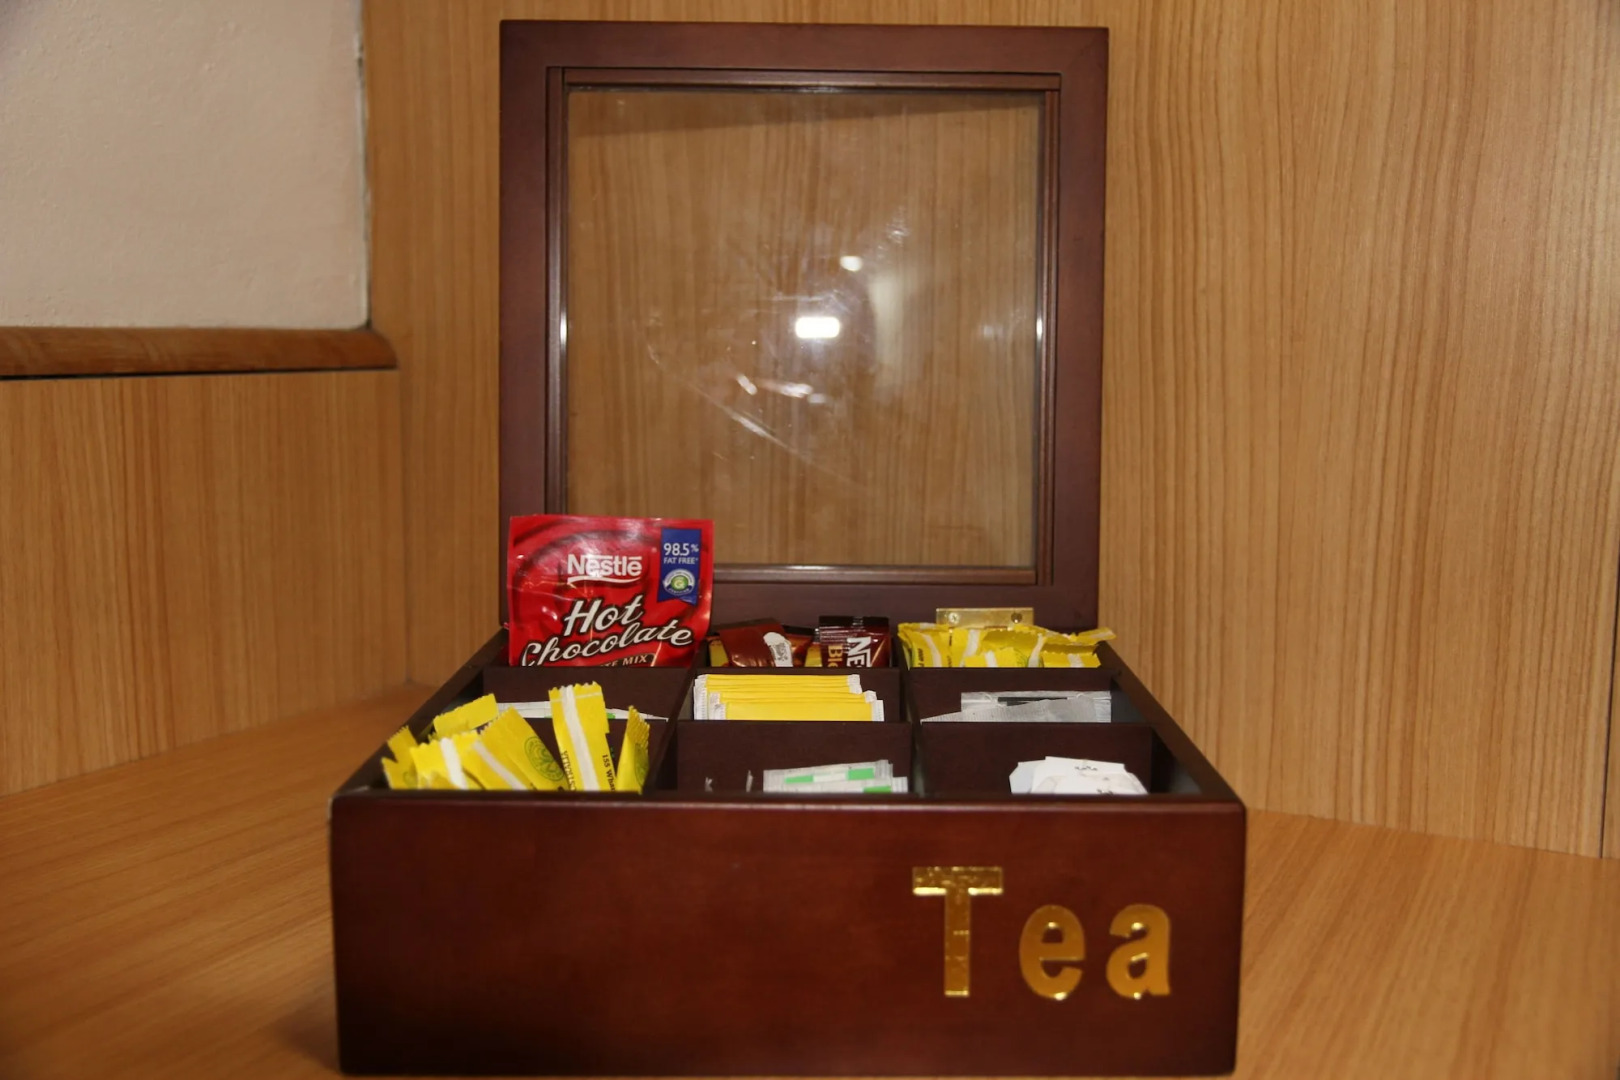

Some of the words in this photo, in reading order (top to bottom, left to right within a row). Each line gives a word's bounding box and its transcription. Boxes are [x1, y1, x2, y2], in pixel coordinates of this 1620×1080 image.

[663, 542, 699, 556] 98.5%
[563, 595, 645, 636] Hot
[521, 620, 693, 666] Chocolate
[622, 654, 647, 666] MIX
[846, 636, 871, 667] NE
[912, 866, 1171, 999] Tea
